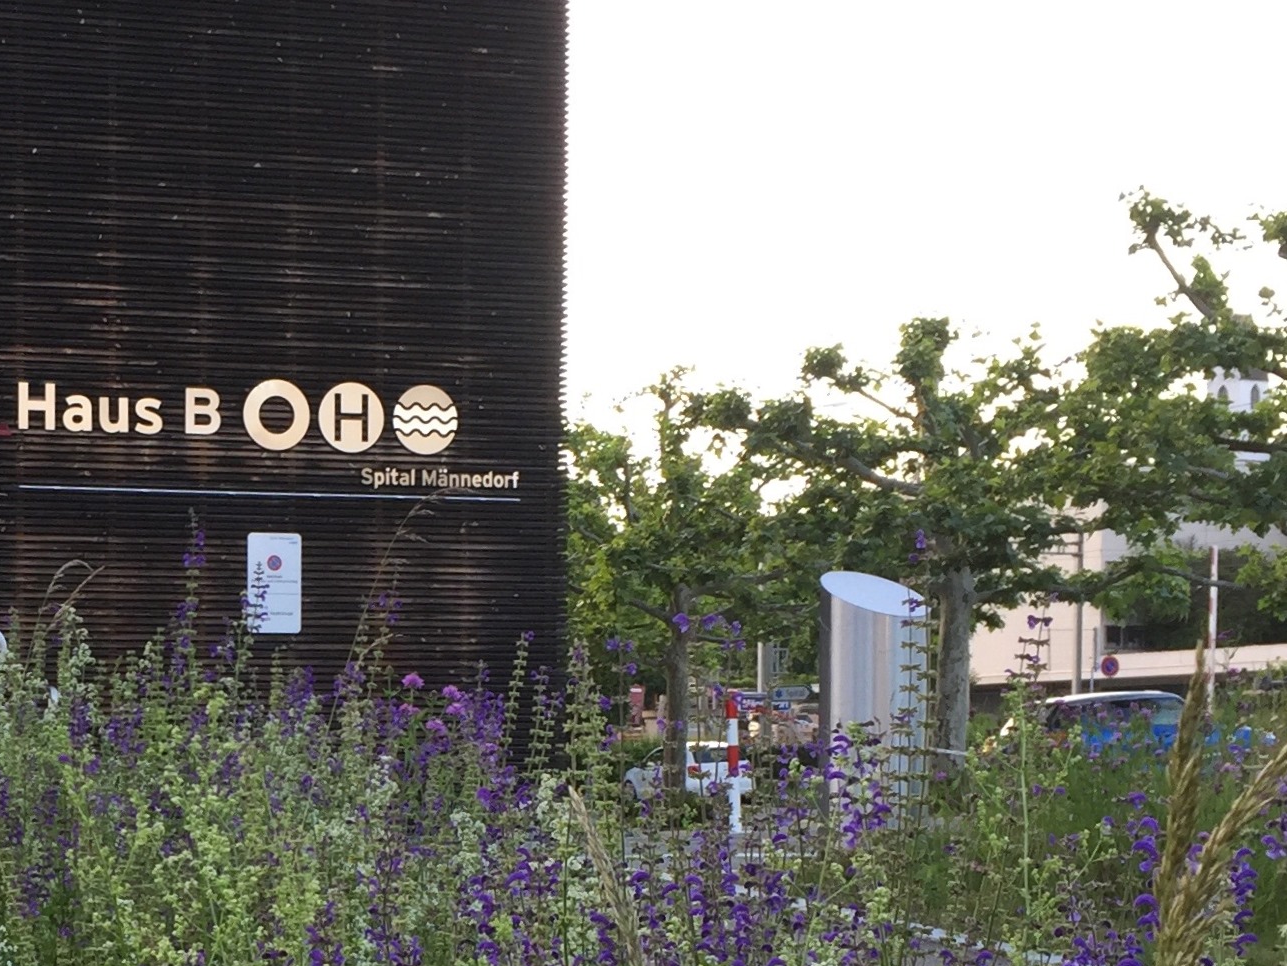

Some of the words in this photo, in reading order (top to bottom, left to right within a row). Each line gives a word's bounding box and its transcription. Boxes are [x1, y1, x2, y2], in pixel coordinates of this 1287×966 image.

[16, 381, 163, 435] Haus
[185, 387, 222, 435] B
[361, 467, 416, 489] Spital
[422, 468, 520, 489] Männedorf
